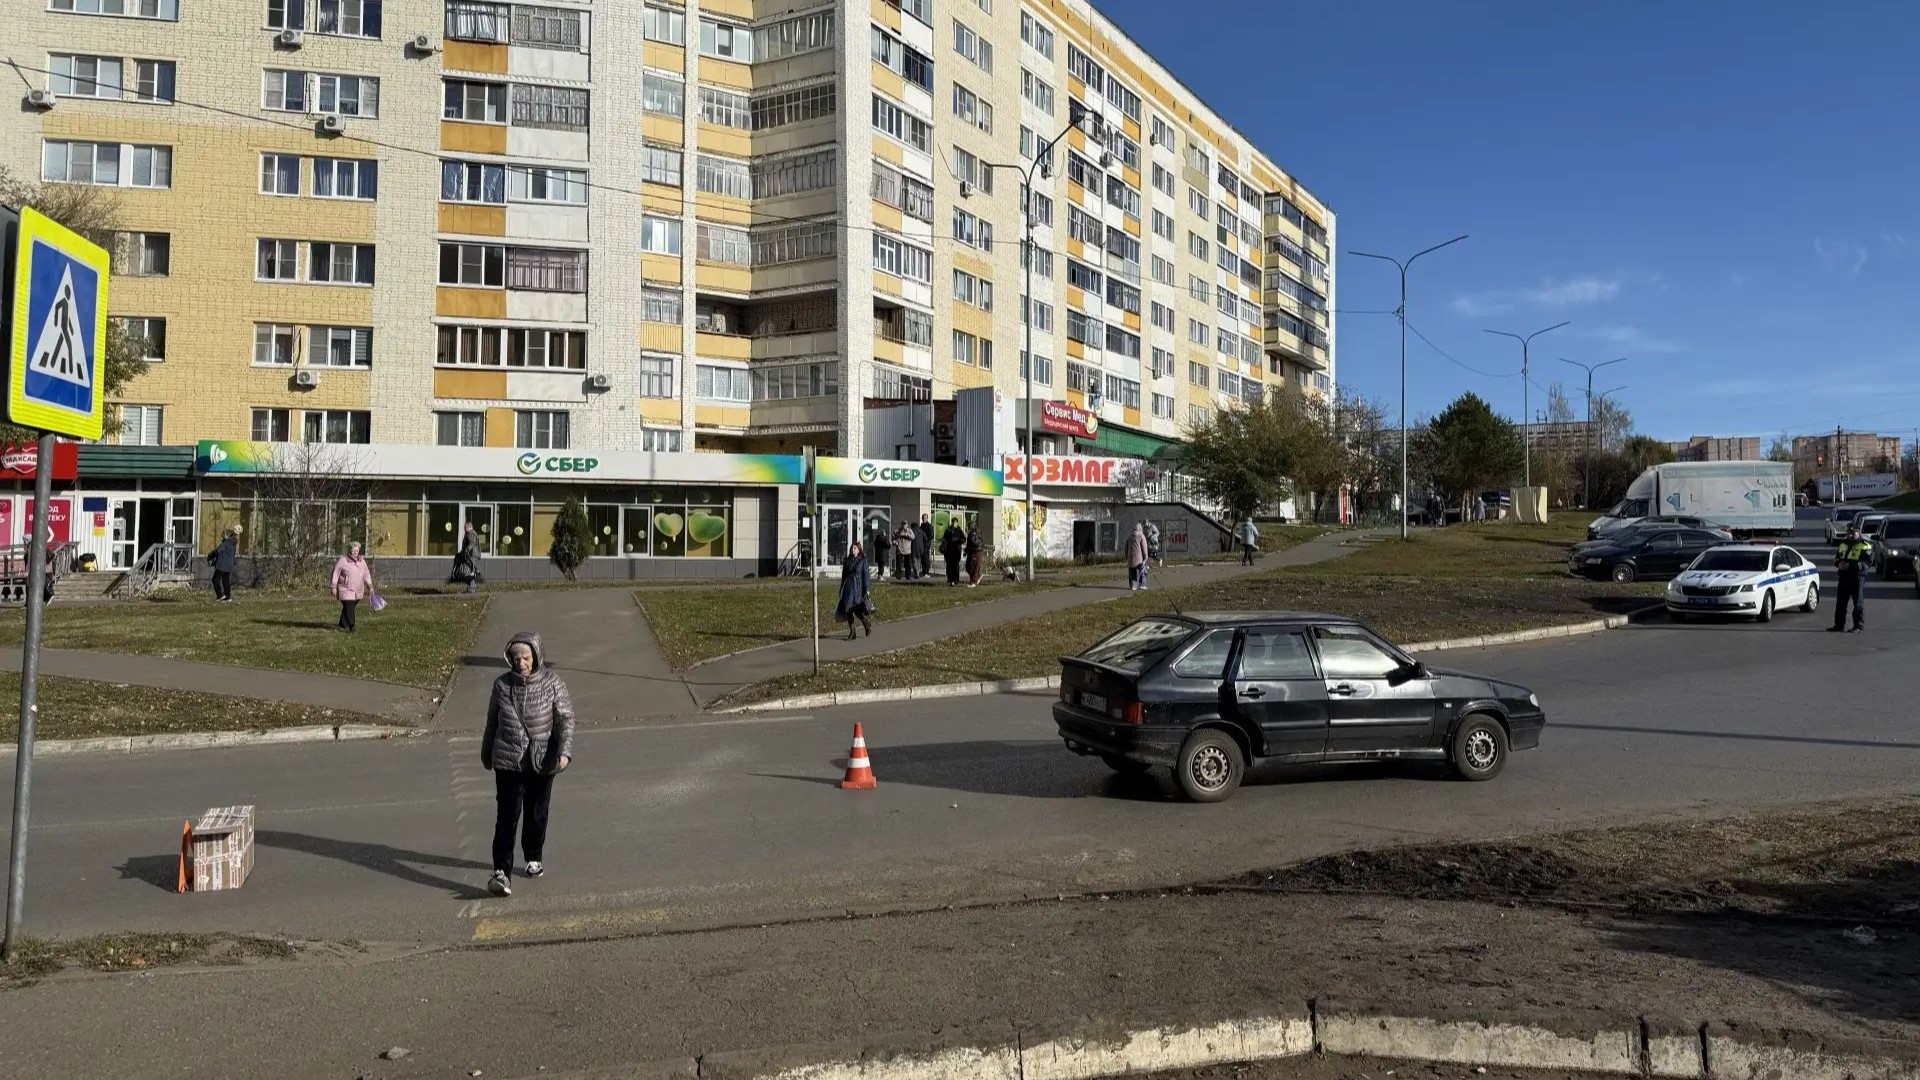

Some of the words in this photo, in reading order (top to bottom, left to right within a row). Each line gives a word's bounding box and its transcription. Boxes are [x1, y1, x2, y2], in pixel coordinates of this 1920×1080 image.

[1045, 401, 1071, 420] Сервис
[545, 456, 599, 472] СБЕР
[1005, 456, 1114, 483] ХОЗМАГ
[880, 467, 920, 481] СБЕР
